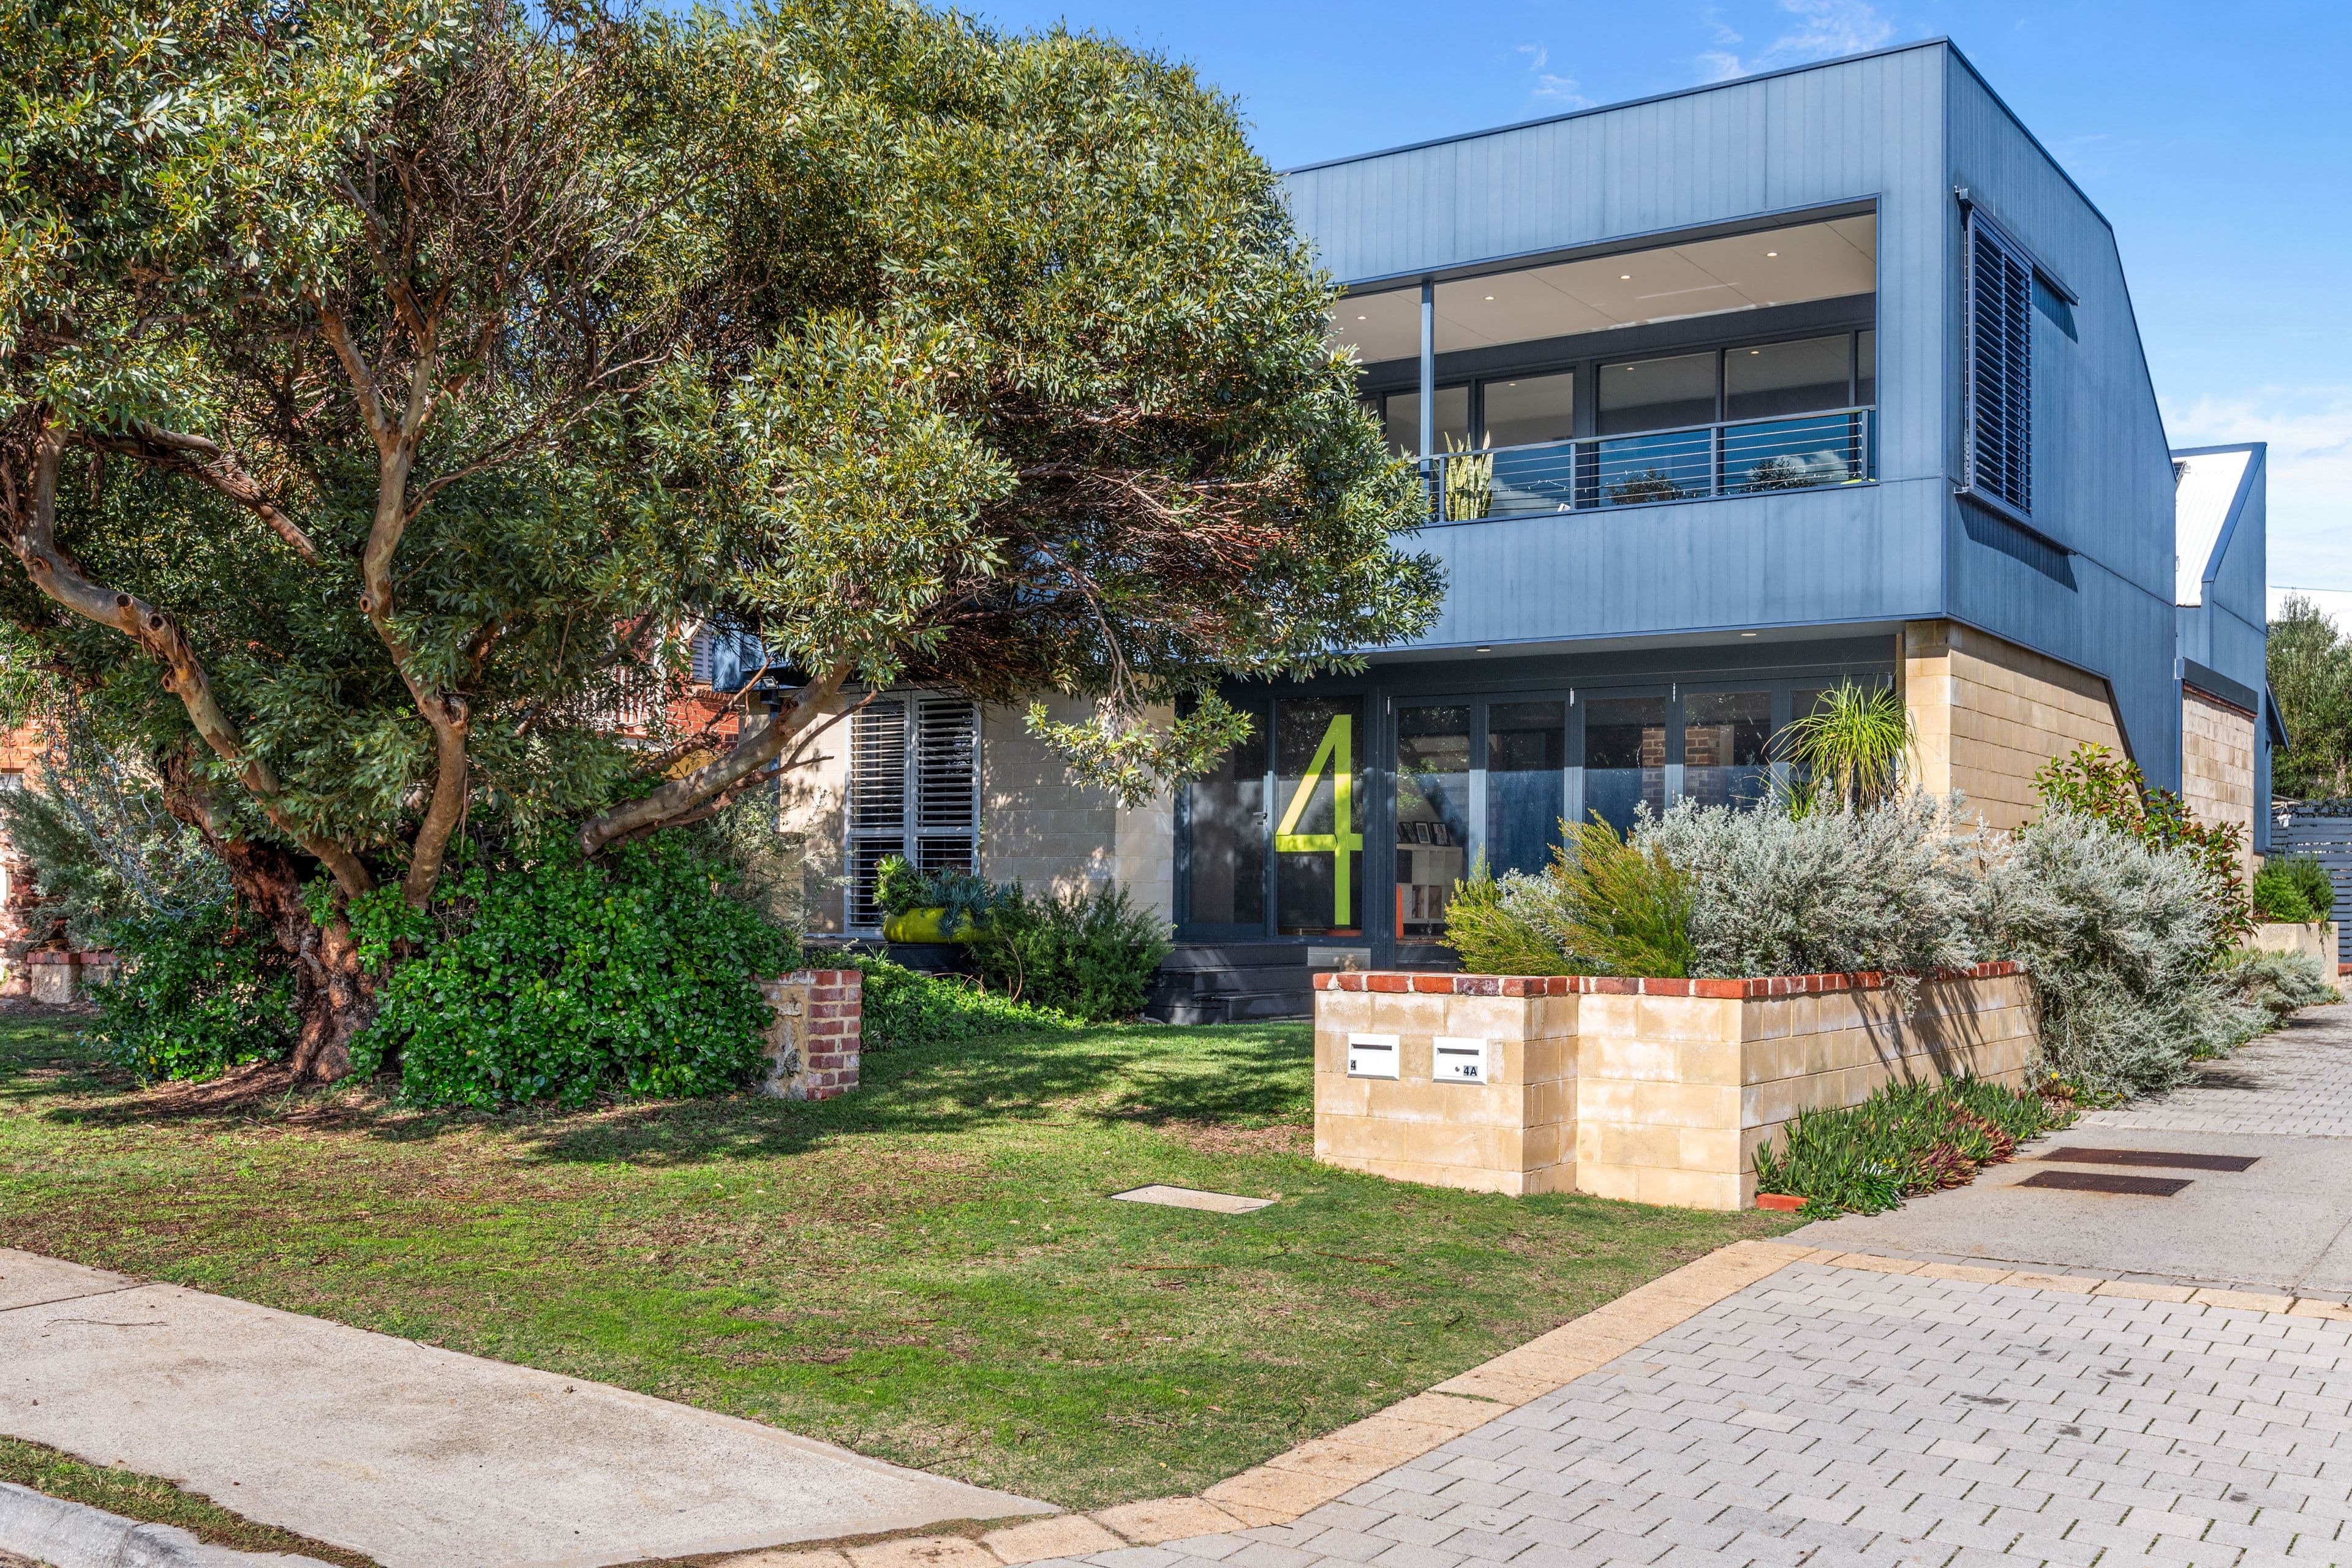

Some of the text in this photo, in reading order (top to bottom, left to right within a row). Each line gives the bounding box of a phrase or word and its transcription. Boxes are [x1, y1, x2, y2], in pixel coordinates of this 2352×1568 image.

[1275, 714, 1363, 925] 4
[1351, 1060, 1356, 1069] 4
[1464, 1066, 1477, 1076] 4A
